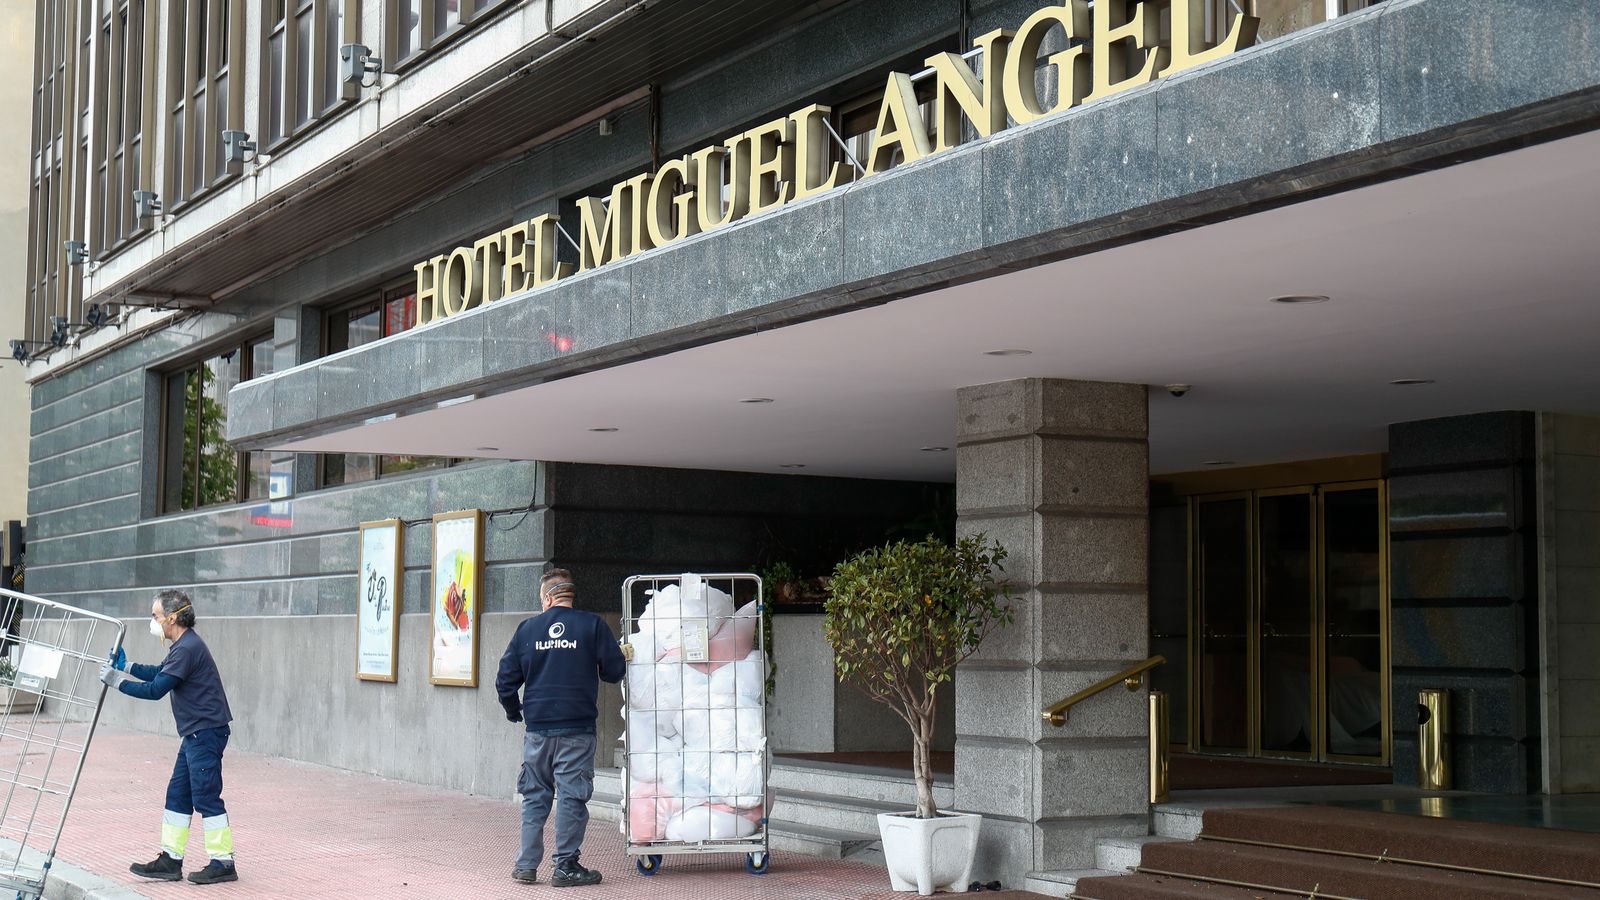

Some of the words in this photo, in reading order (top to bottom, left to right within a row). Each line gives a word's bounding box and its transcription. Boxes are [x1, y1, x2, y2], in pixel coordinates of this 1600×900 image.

[413, 212, 562, 328] HOTEL
[575, 103, 841, 276] MIGUEL
[861, 0, 1248, 179] ANGEL
